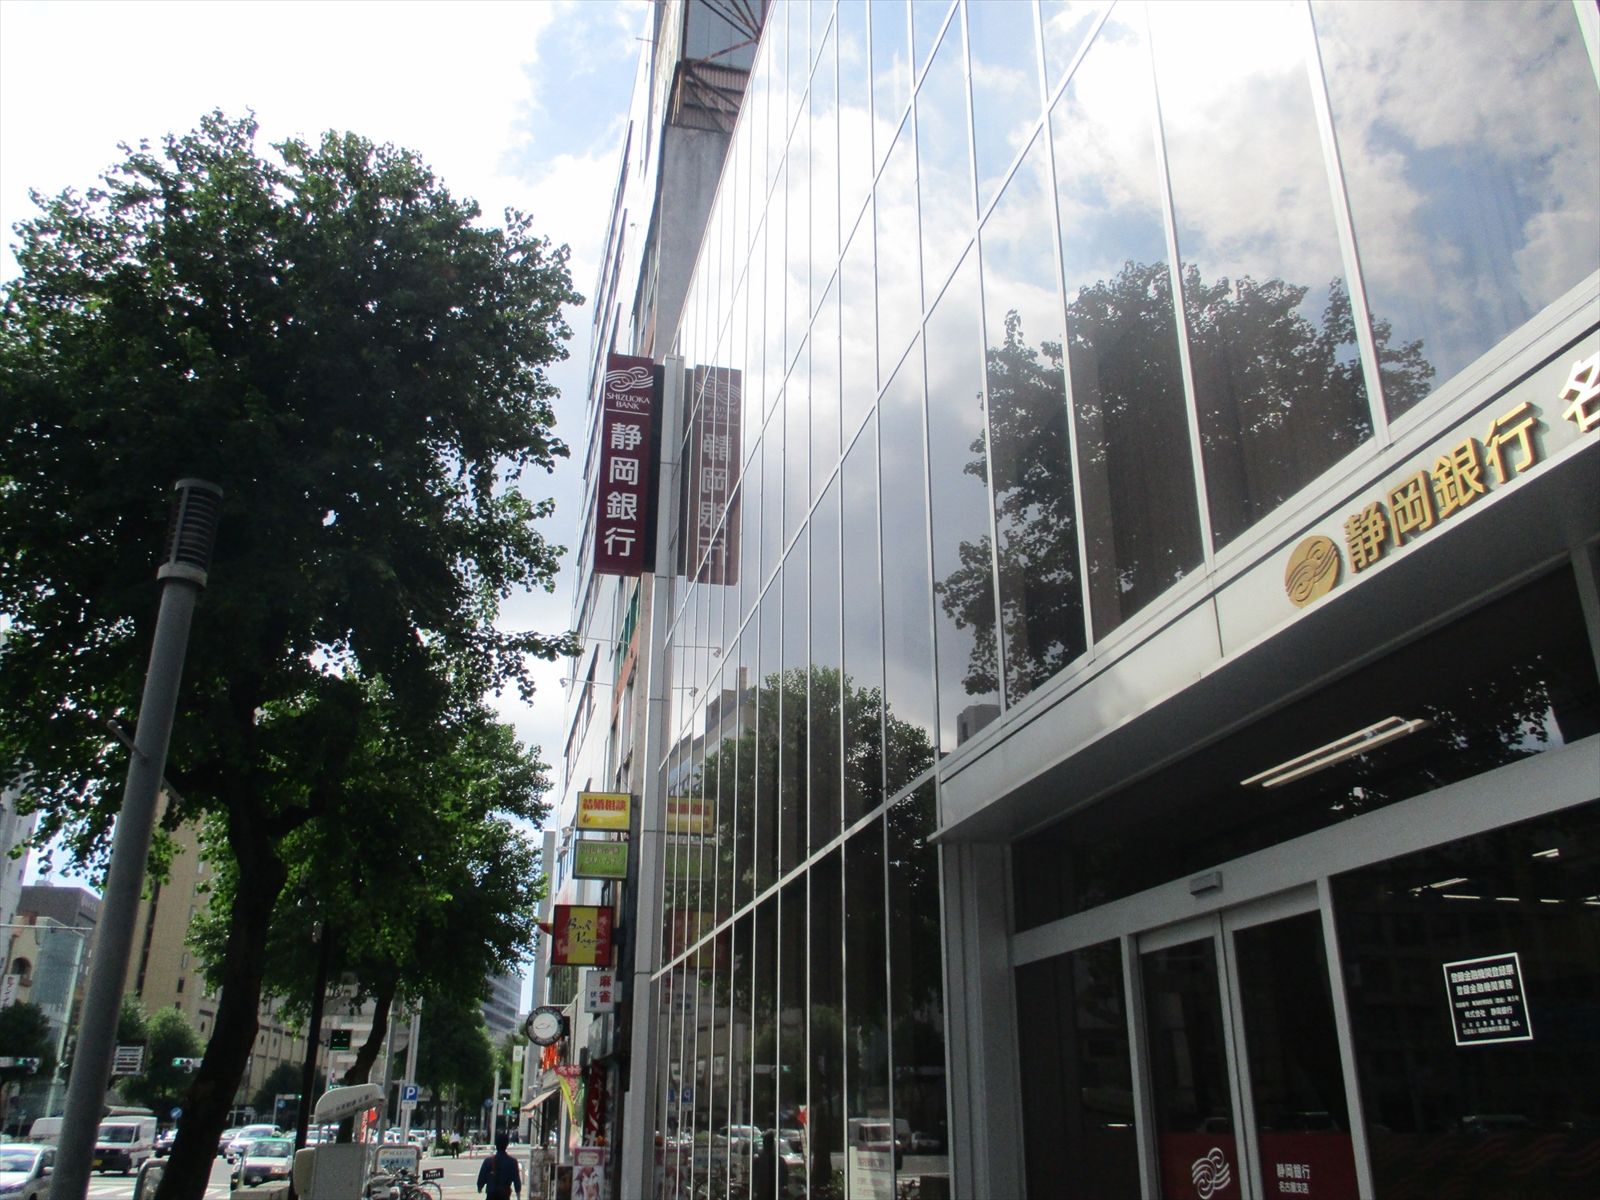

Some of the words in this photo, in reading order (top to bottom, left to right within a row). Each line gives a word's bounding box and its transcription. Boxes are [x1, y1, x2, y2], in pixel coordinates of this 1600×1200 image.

[606, 393, 650, 404] SHIZUOKA
[616, 401, 639, 410] BANK
[604, 422, 642, 557] 静岡銀行
[1344, 402, 1537, 574] 静岡銀行
[406, 1087, 416, 1099] P
[1276, 1164, 1311, 1179] 静岡銀行
